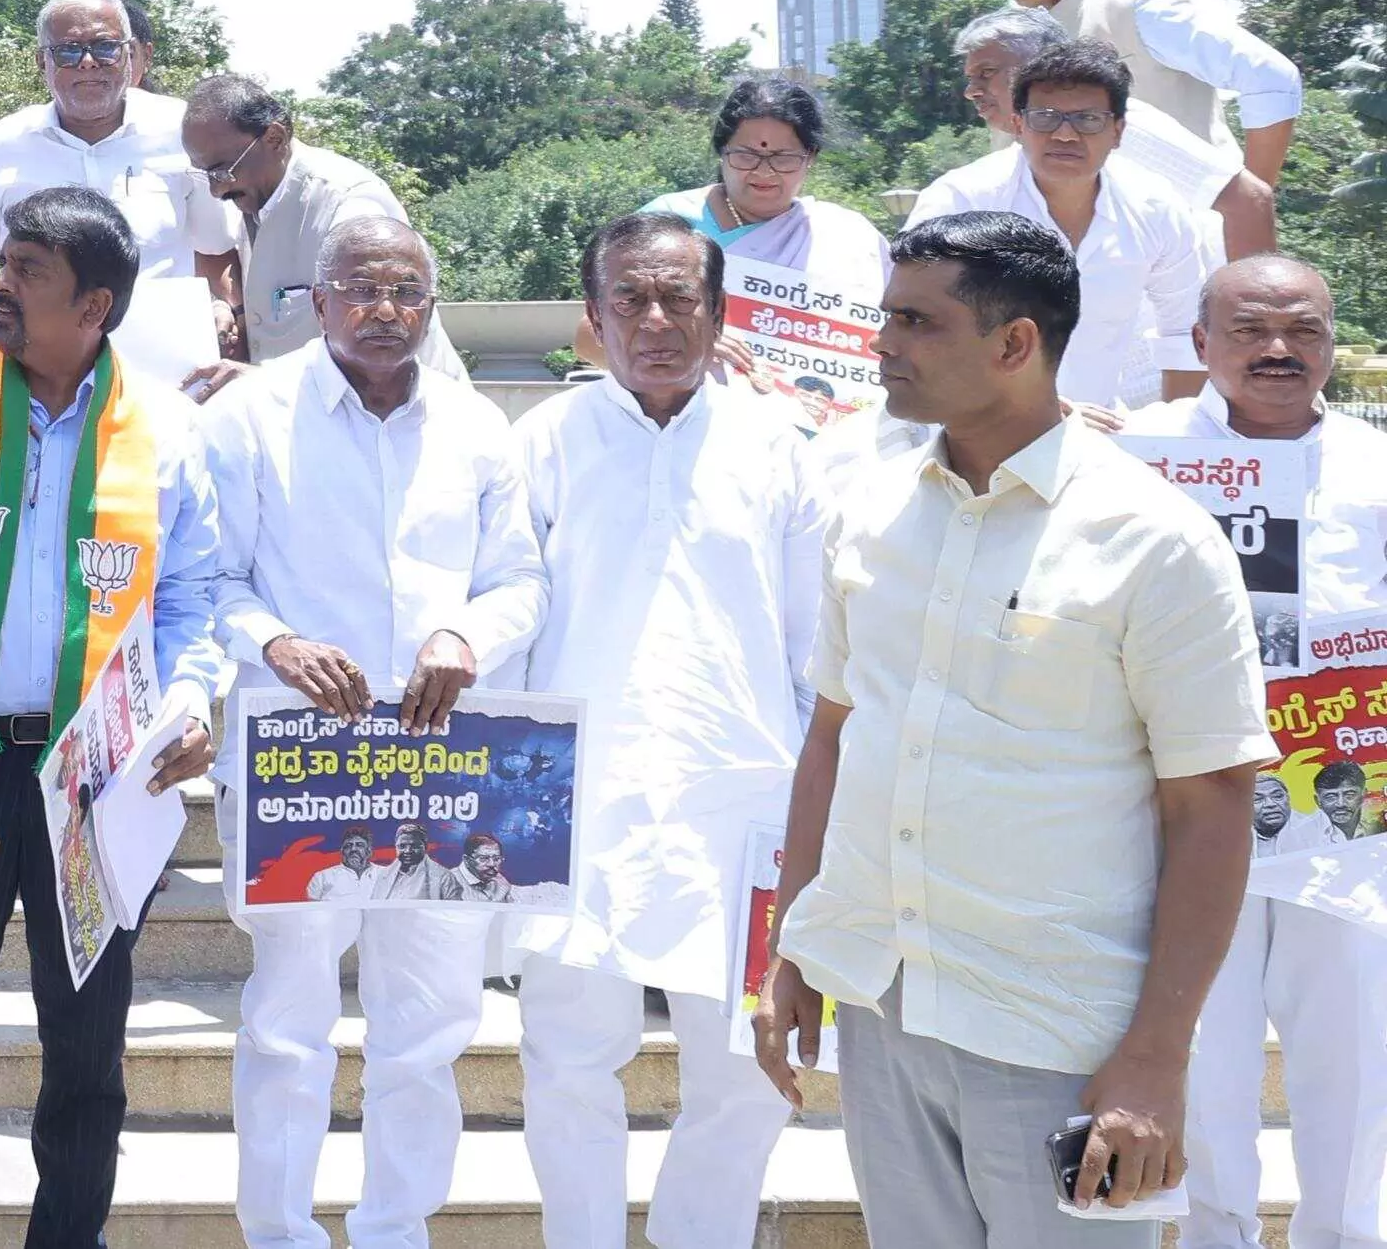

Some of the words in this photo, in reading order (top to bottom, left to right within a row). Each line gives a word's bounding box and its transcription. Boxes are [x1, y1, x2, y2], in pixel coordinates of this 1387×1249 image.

[744, 275, 843, 311] ಕಾಂಗ್ರೆಸ್
[254, 744, 338, 783] ಭದ್ರತಾ
[346, 741, 490, 788] ವೈಫಲ್ಯದಿಂದ
[257, 788, 420, 824] ಅಮಾಯಕರು
[428, 791, 479, 821] ಬಲಿ
